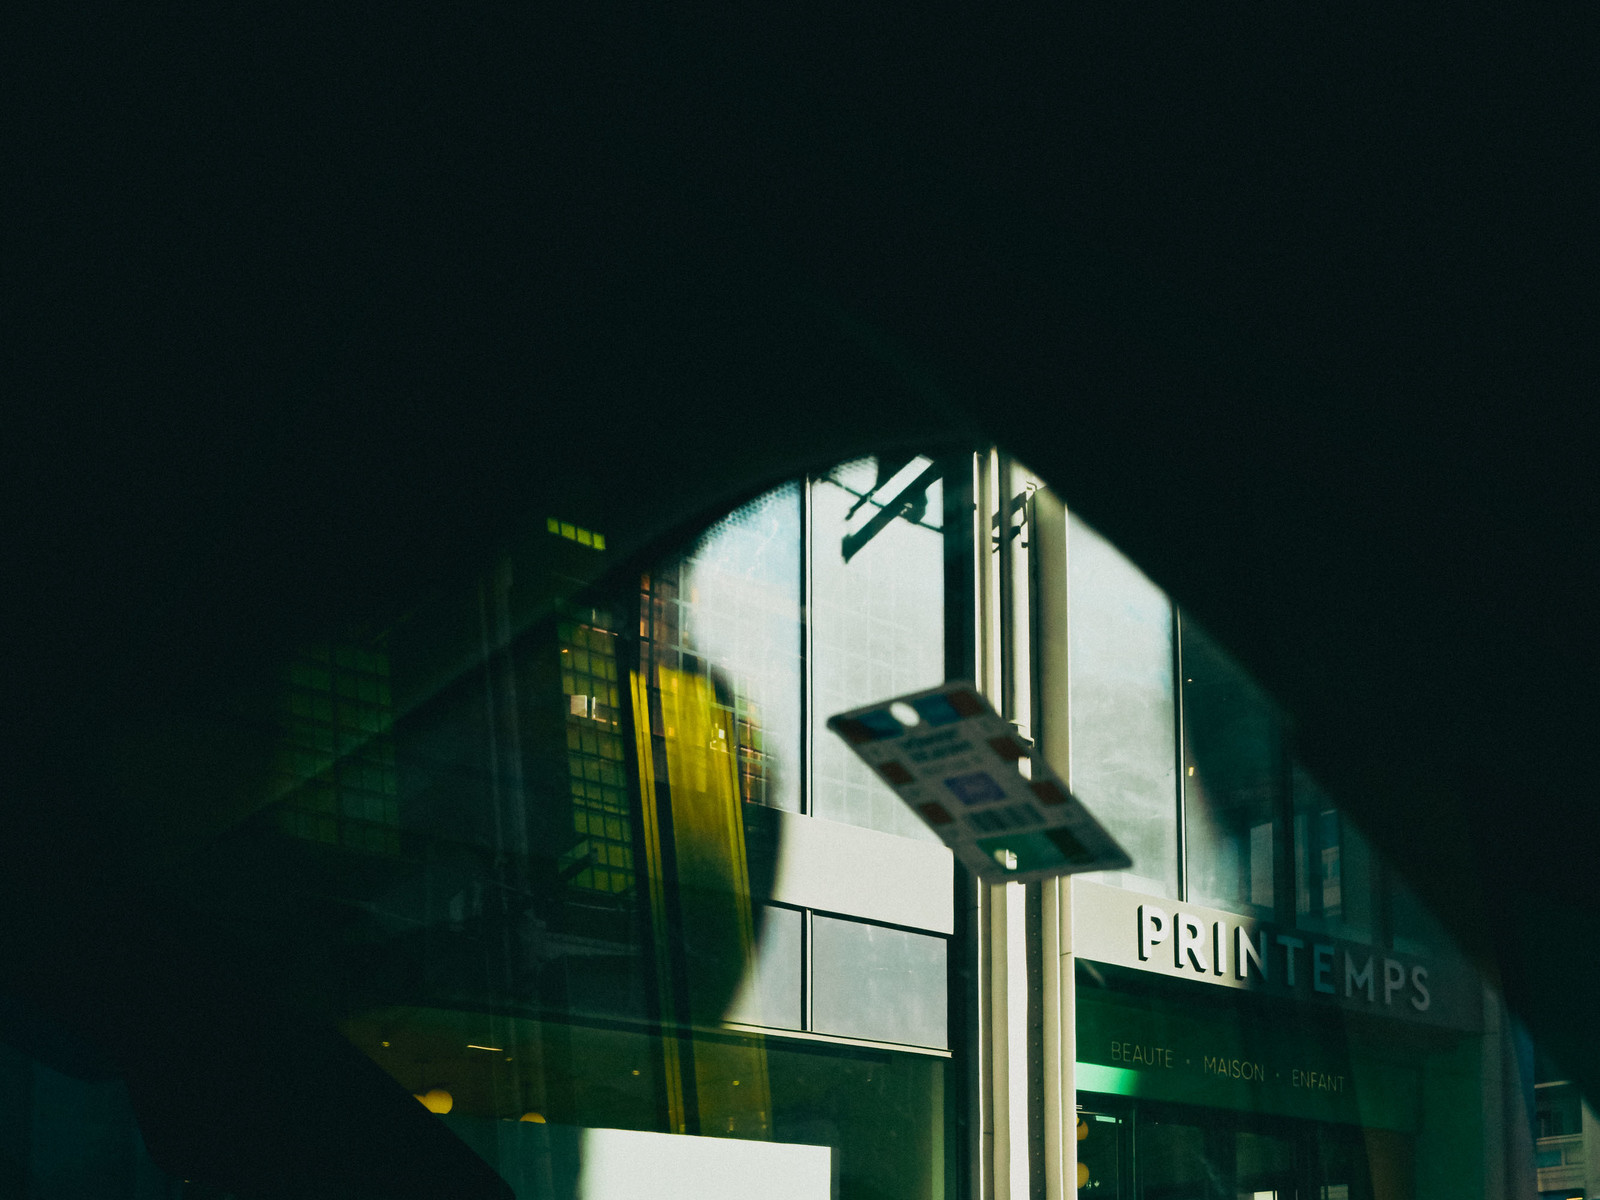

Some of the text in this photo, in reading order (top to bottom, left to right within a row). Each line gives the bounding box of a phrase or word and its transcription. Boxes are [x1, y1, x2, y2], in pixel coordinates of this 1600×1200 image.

[1137, 904, 1431, 1012] PRINTEMPS
[1111, 1041, 1344, 1092] BEAUTE MAISON ENFANT
